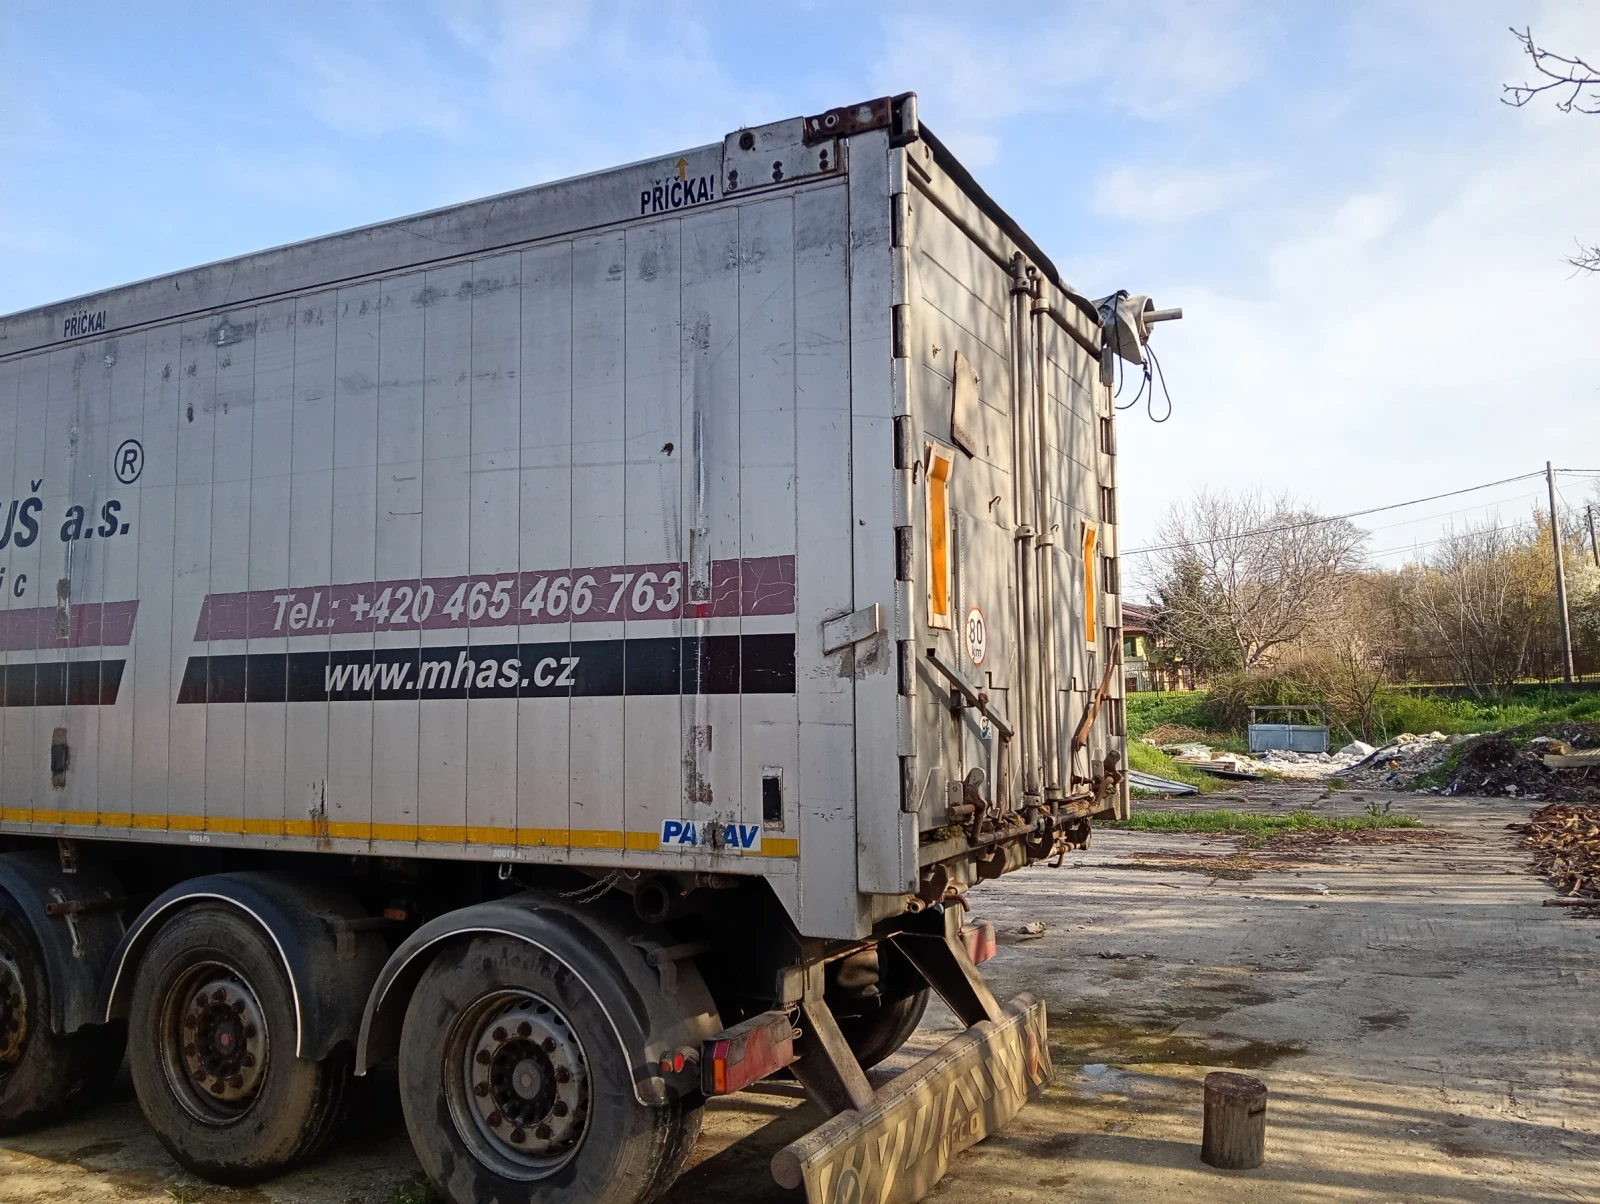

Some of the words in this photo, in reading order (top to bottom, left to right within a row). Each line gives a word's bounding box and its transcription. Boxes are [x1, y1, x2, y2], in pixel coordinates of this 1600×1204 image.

[640, 173, 715, 214] PŘÍČKA!
[63, 309, 107, 338] PŘÍČKA!
[60, 499, 130, 543] a.s.
[350, 584, 434, 626] +420
[442, 578, 515, 621] 465
[520, 574, 596, 618] 466
[606, 570, 681, 614] 763
[969, 618, 982, 644] 80
[971, 644, 982, 657] km
[325, 651, 580, 692] www.mhas.cz
[662, 820, 759, 848] PAAV
